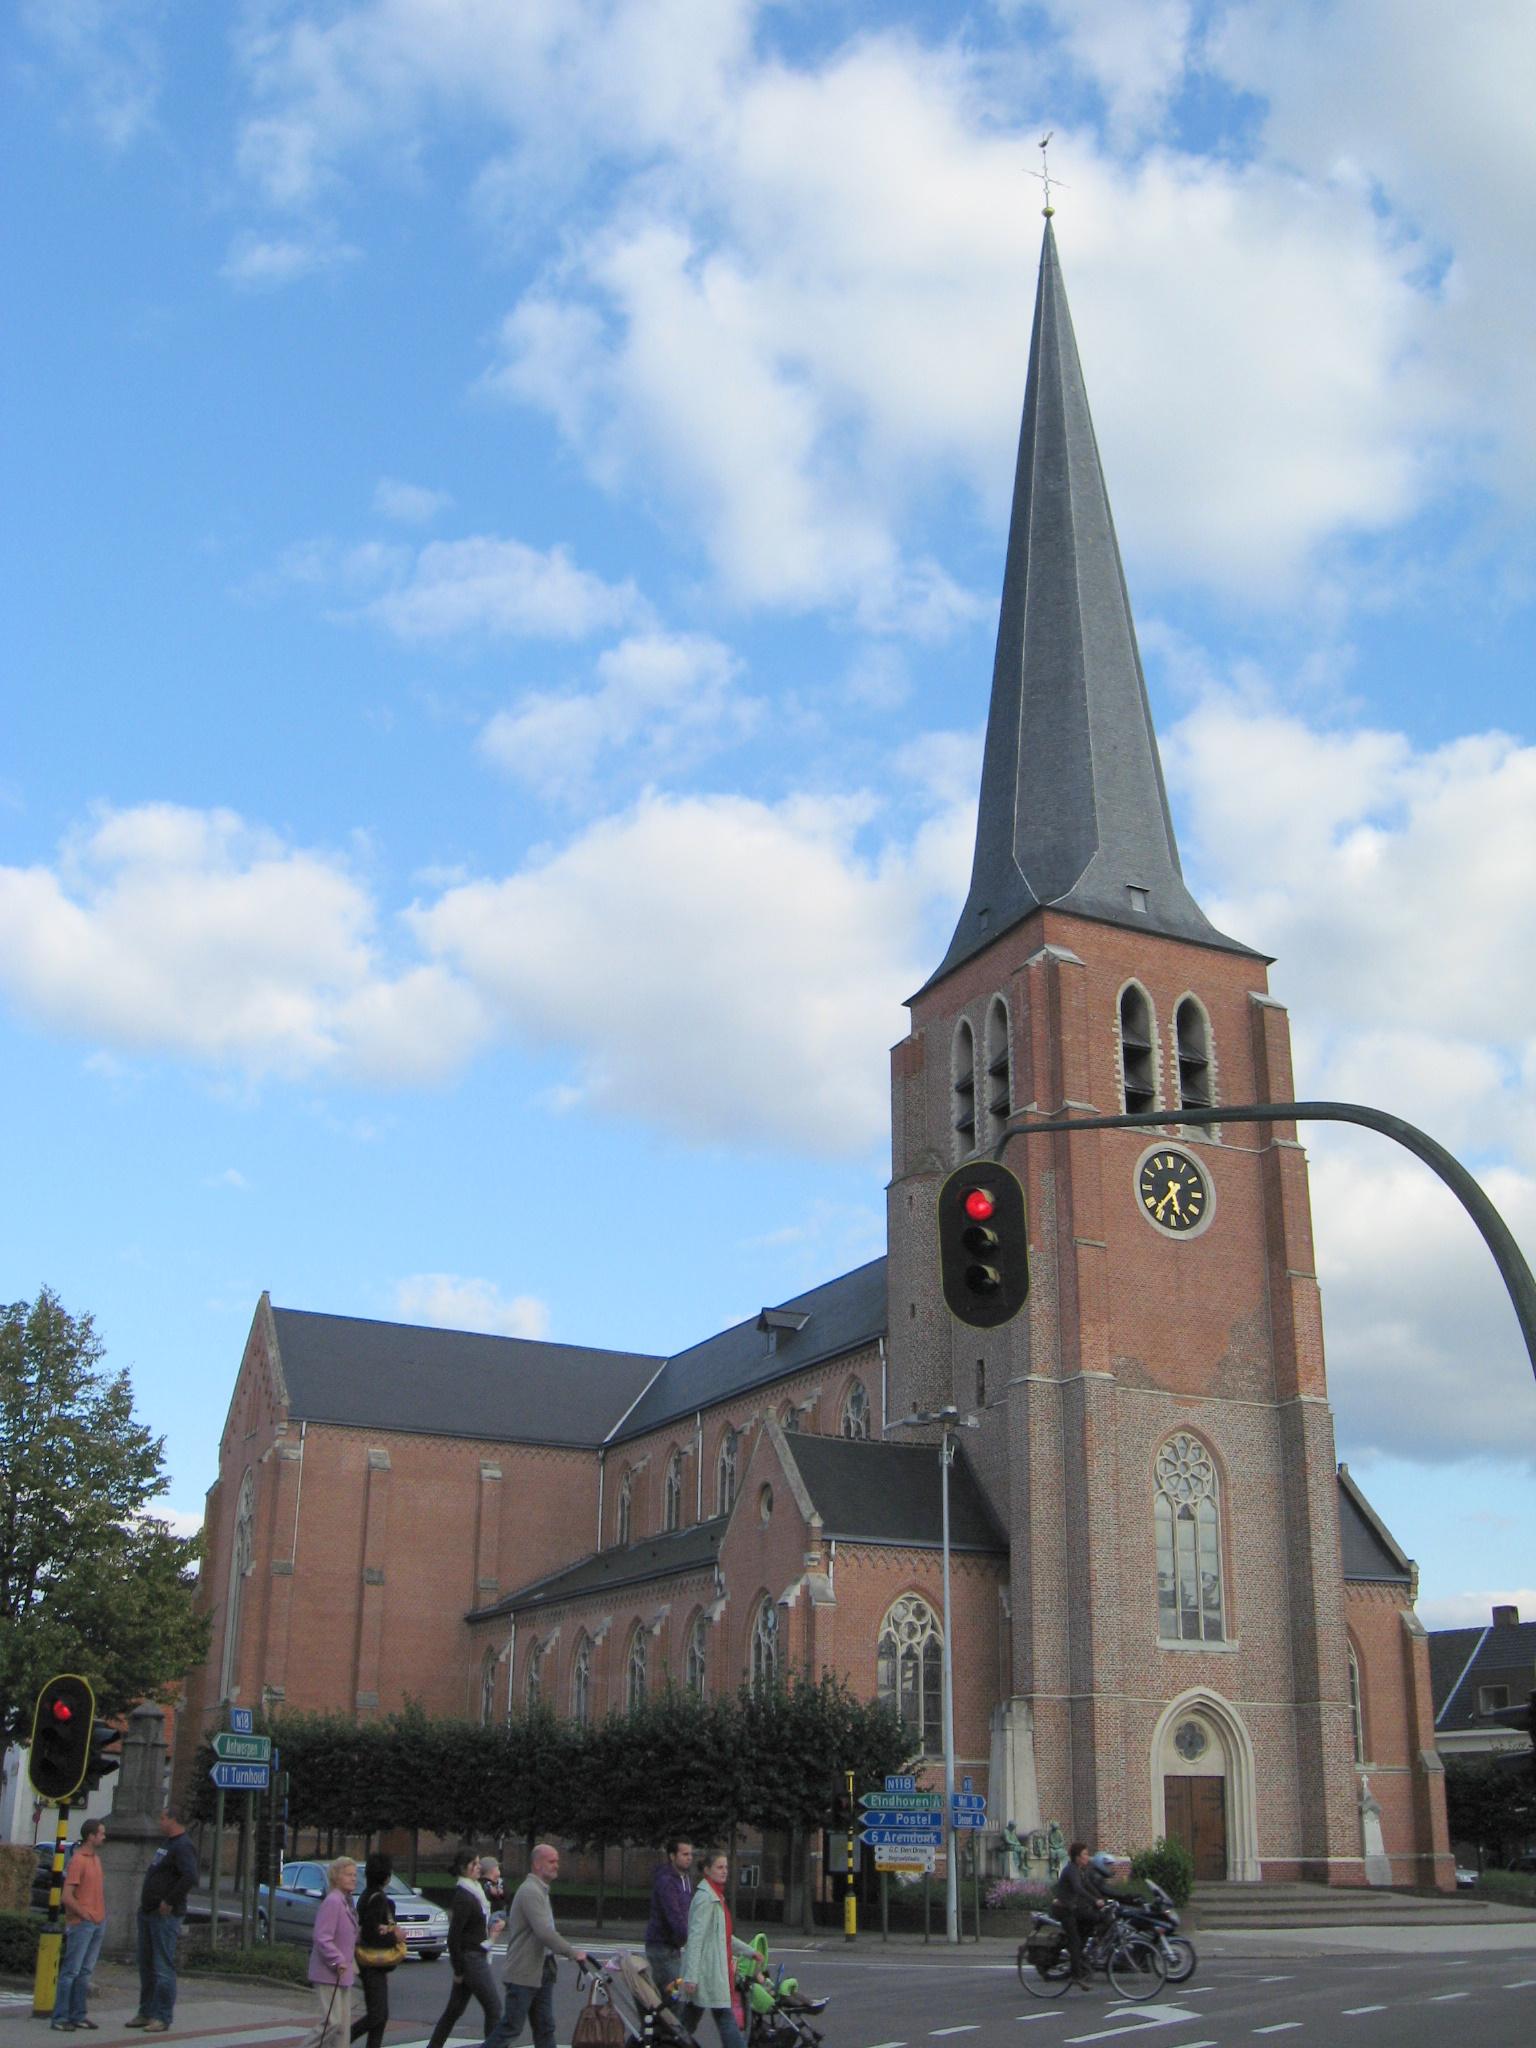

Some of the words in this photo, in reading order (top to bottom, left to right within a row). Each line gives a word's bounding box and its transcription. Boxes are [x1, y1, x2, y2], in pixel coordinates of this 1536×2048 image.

[236, 1712, 249, 1729] N18
[232, 1767, 265, 1784] Turnhout
[887, 1780, 912, 1789] N118
[871, 1795, 929, 1806] Eindhoven
[879, 1814, 886, 1824] 7
[896, 1813, 932, 1825] Postel
[871, 1831, 878, 1842] 6
